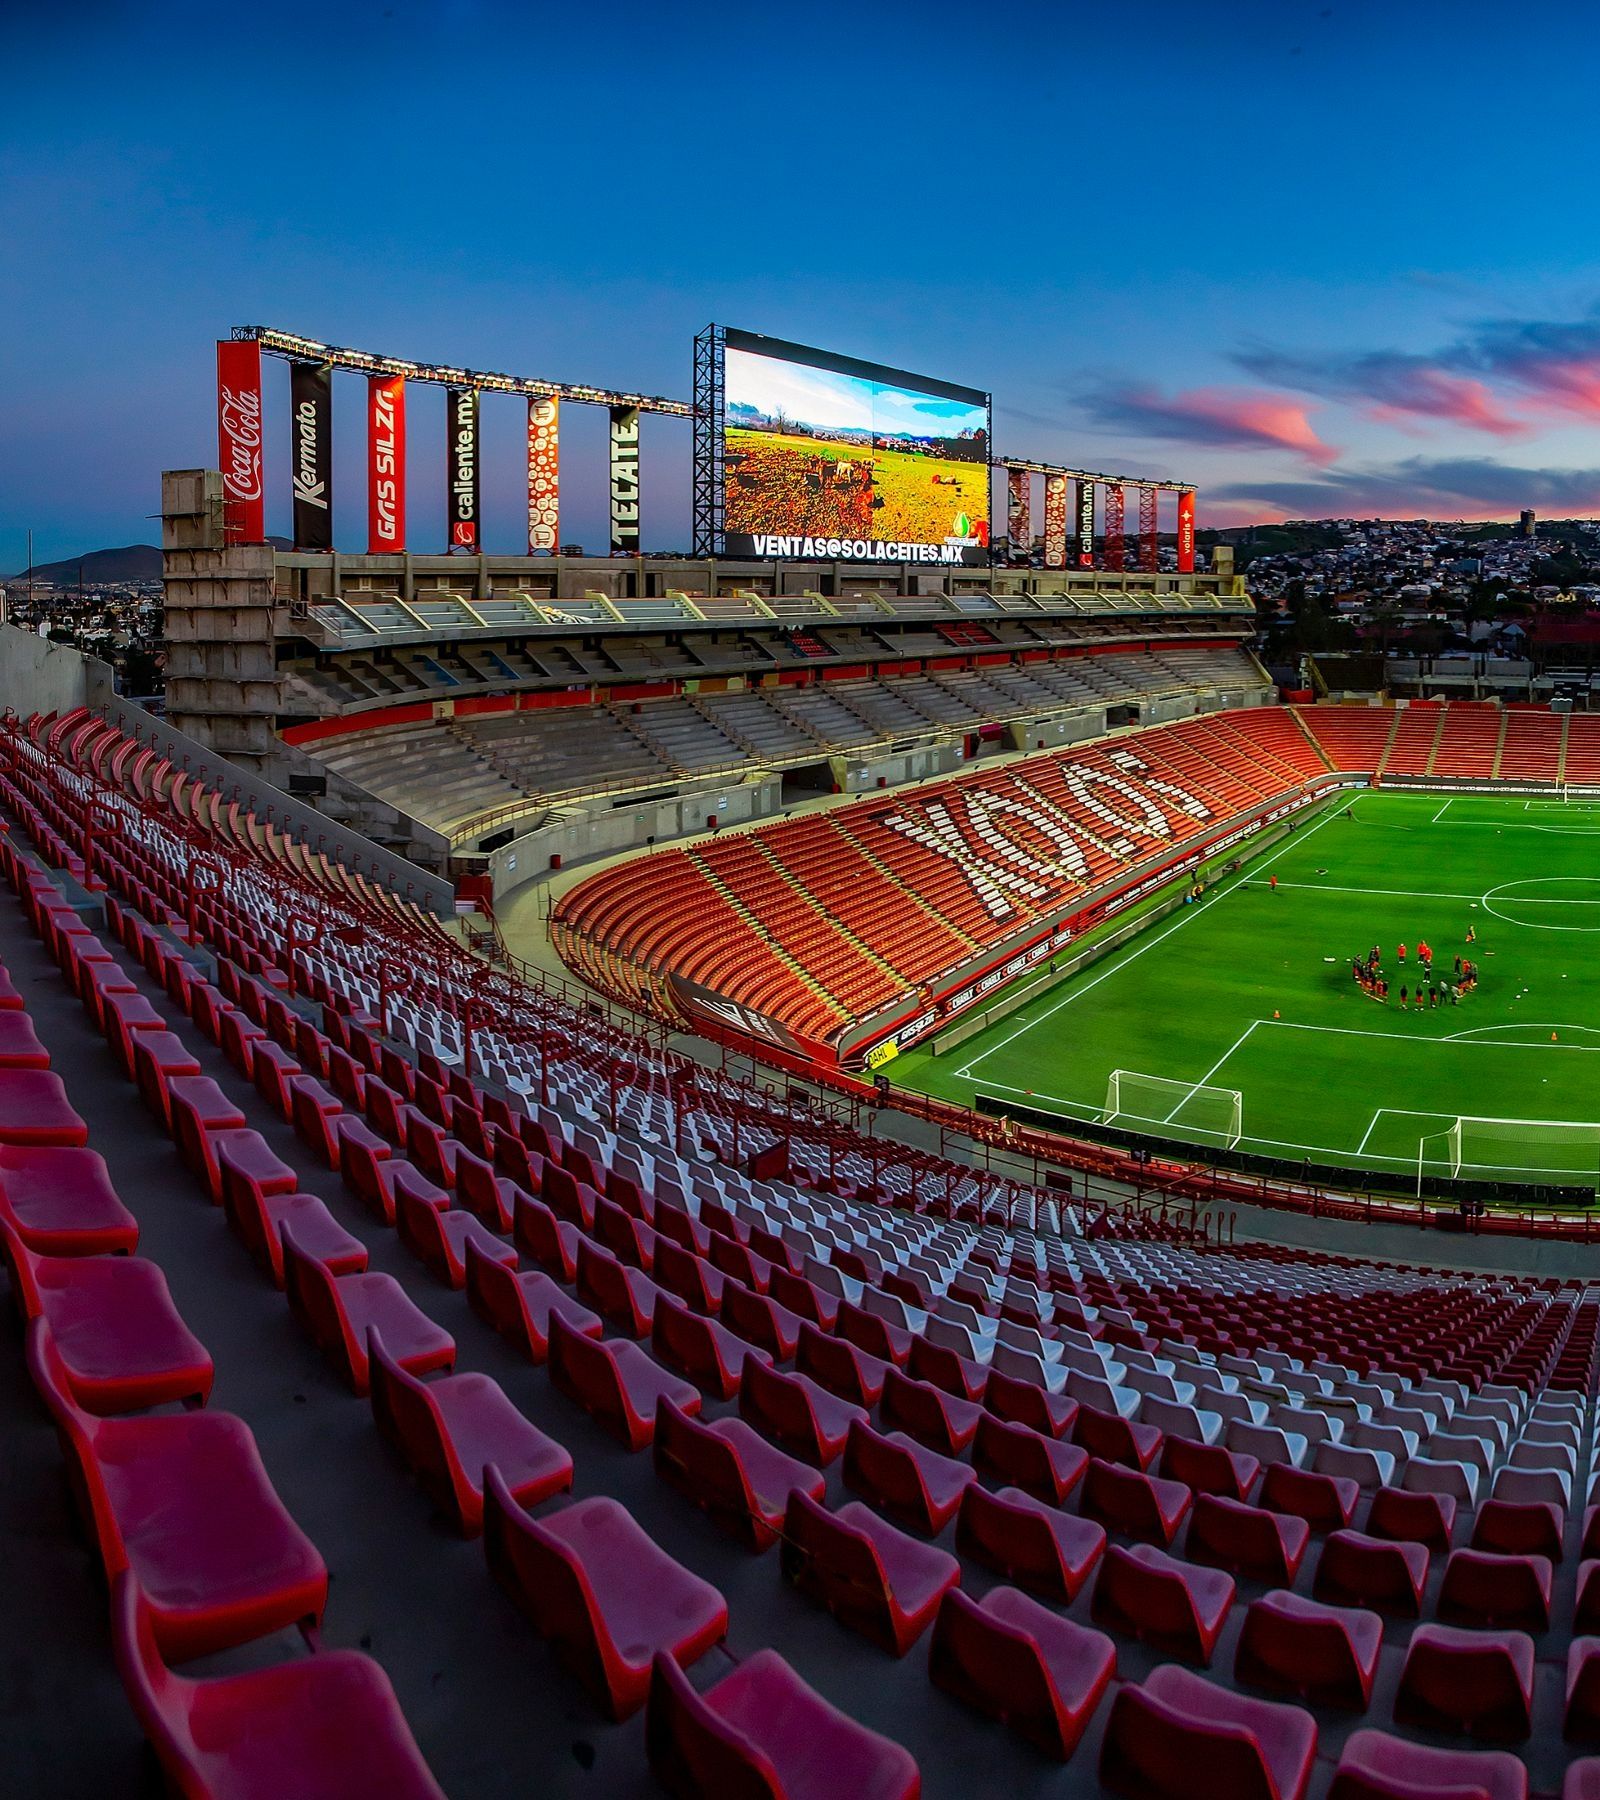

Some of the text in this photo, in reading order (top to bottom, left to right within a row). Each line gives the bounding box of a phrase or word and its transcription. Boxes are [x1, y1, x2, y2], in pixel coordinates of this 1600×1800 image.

[453, 390, 474, 520] caliente.mx
[1079, 481, 1094, 553] caliente.mx
[1182, 523, 1191, 554] volaris
[752, 534, 964, 563] VENTAS@SOLACEITES.MX
